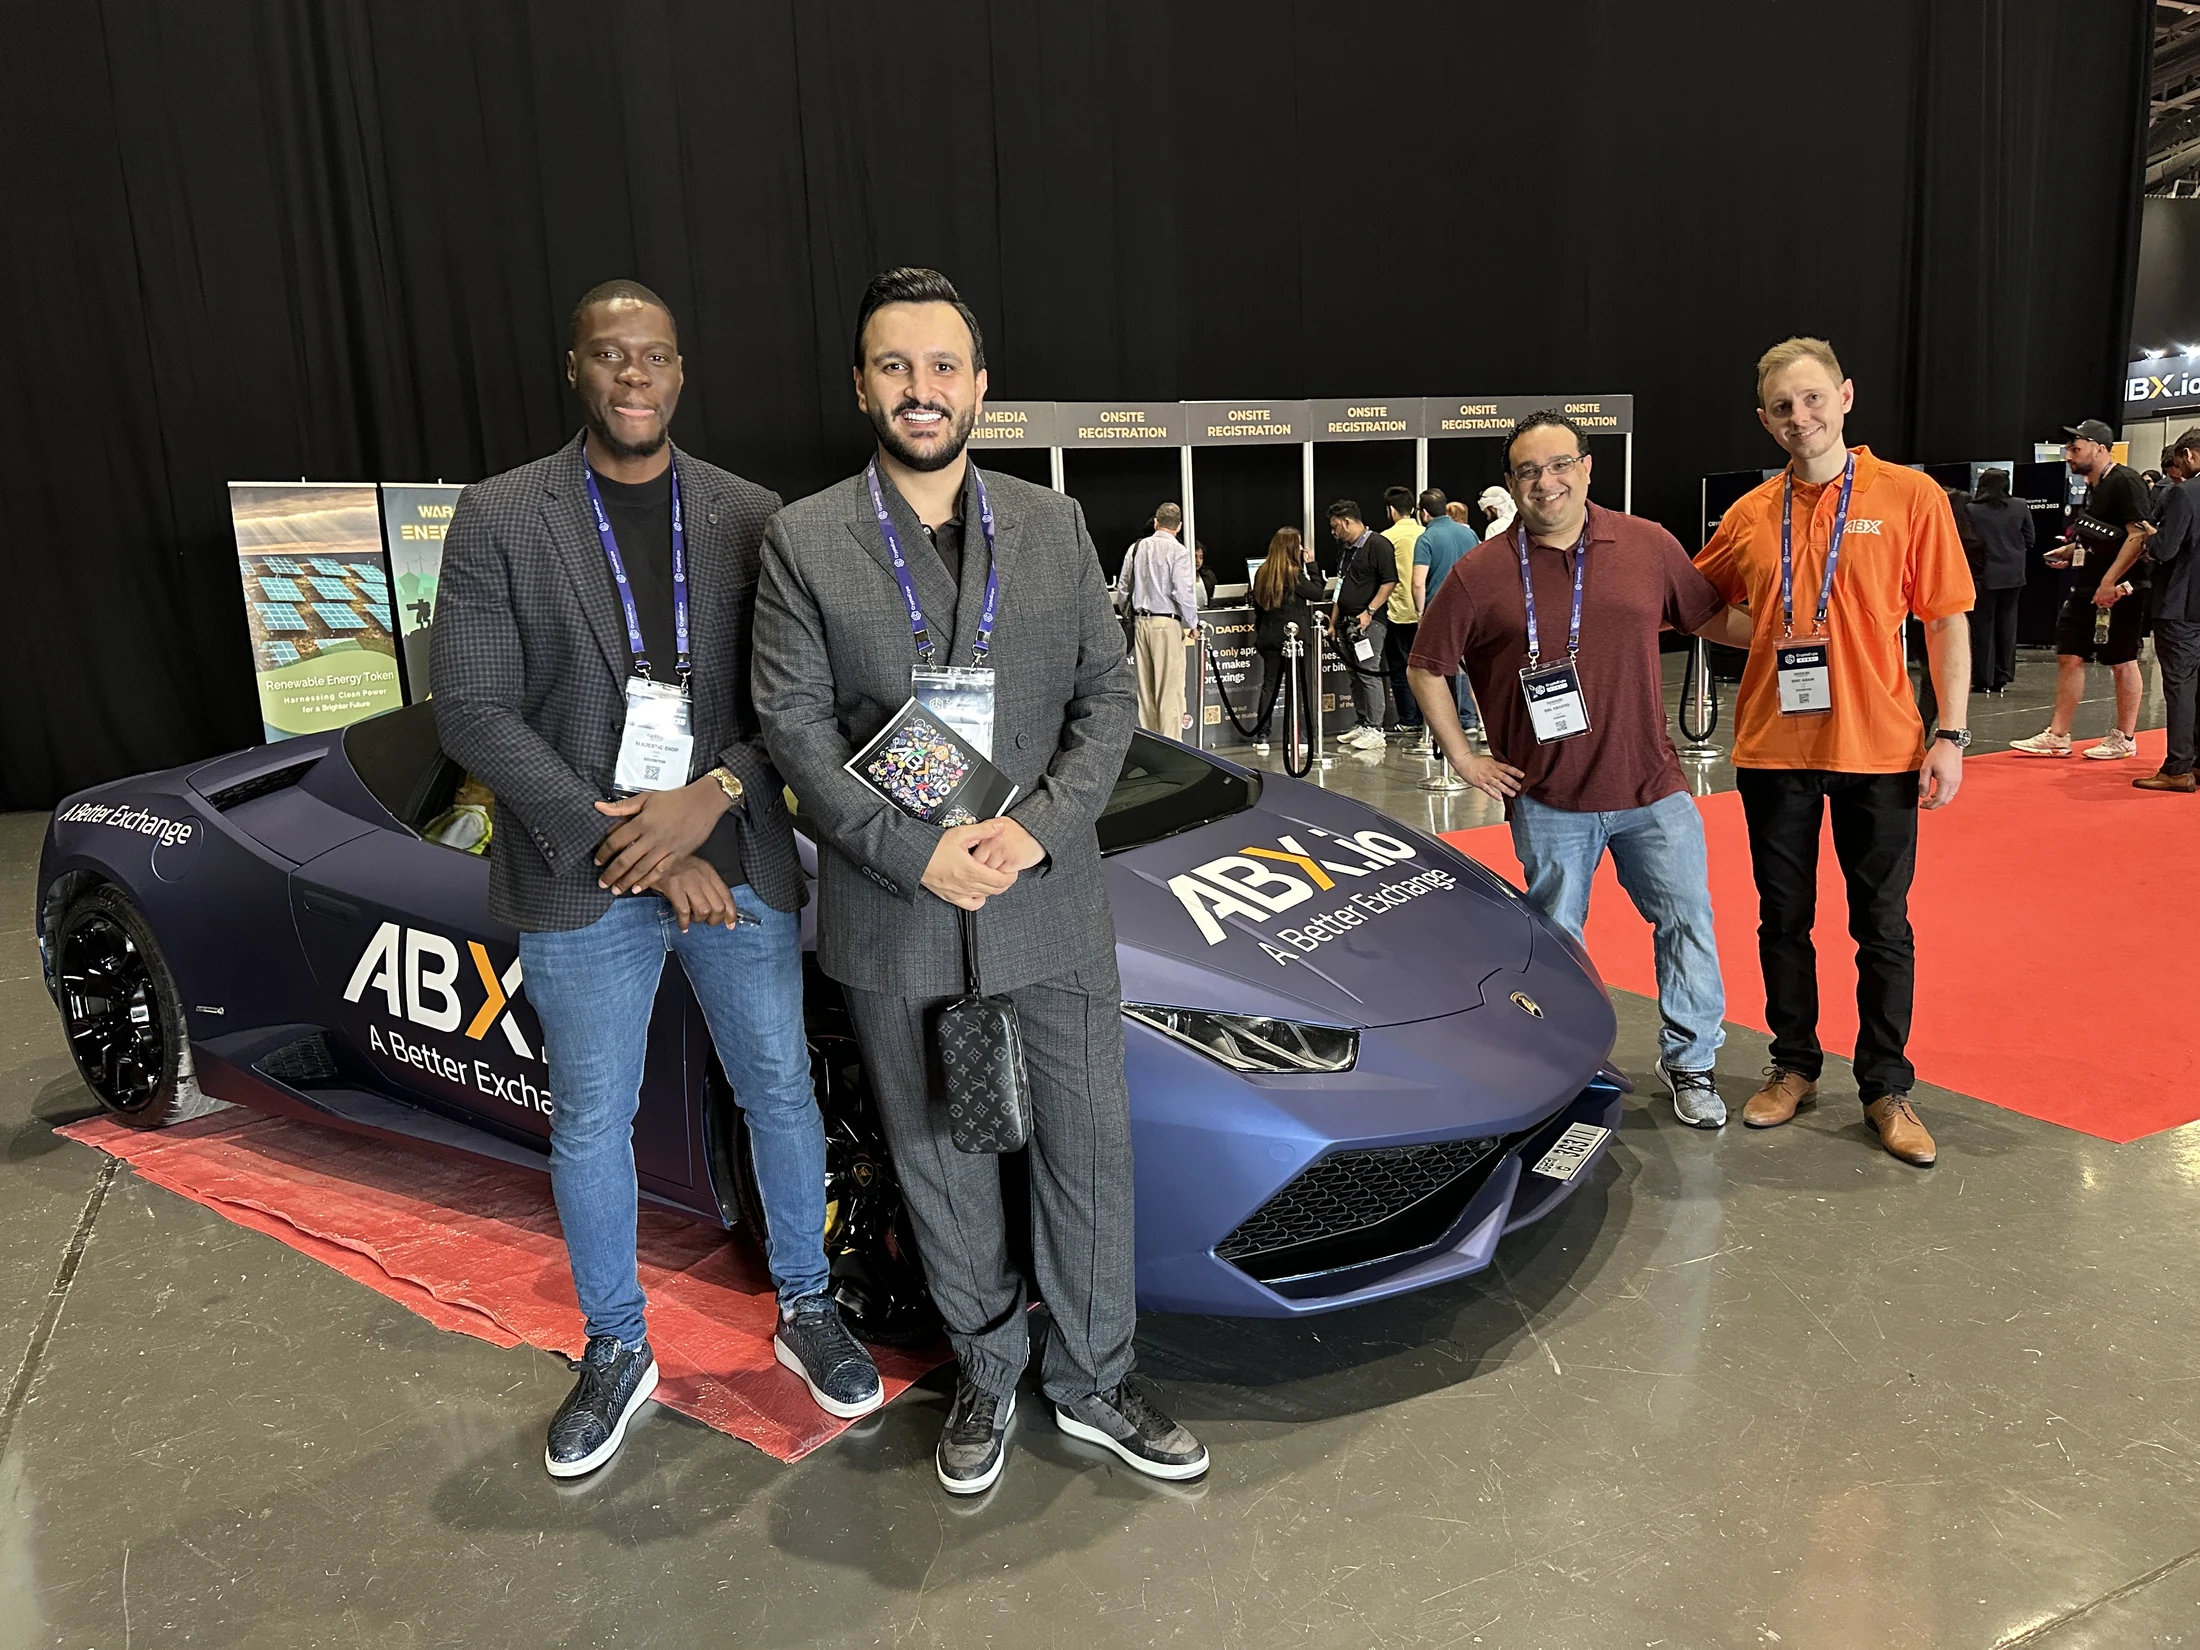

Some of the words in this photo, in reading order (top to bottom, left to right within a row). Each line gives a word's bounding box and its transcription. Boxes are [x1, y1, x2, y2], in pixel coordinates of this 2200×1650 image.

[2124, 372, 2200, 402] BX.io
[1347, 406, 1387, 418] ONSITE
[1460, 404, 1497, 415] ONSITE
[1564, 403, 1600, 413] ONSITE
[985, 411, 1028, 423] MEDIA
[1100, 411, 1145, 423] ONSITE
[1228, 410, 1271, 421] ONSITE
[1207, 424, 1291, 437] REGISTRATION
[1328, 420, 1406, 433] REGISTRATION
[1441, 418, 1515, 430] REGISTRATION
[1079, 427, 1167, 439] REGISTRATION
[1843, 518, 1884, 535] ABX
[1216, 624, 1255, 635] DARXX
[1220, 647, 1239, 658] only
[1222, 659, 1251, 670] makes
[265, 676, 325, 691] Renewable
[327, 674, 362, 686] Energy
[364, 671, 395, 682] Token
[283, 693, 336, 705] Harnessing
[338, 690, 361, 699] Clean
[362, 688, 387, 696] Power
[302, 705, 313, 713] for
[321, 703, 349, 713] Brighter
[349, 700, 371, 709] Future
[58, 803, 79, 822] A
[69, 803, 115, 824] Better
[106, 805, 193, 847] Exchange
[1166, 828, 1417, 947] ABX.io
[1349, 867, 1457, 915] Exchange
[1276, 903, 1369, 953] Better
[1257, 941, 1300, 967] A
[370, 1025, 388, 1056] A
[389, 1031, 468, 1085] Better
